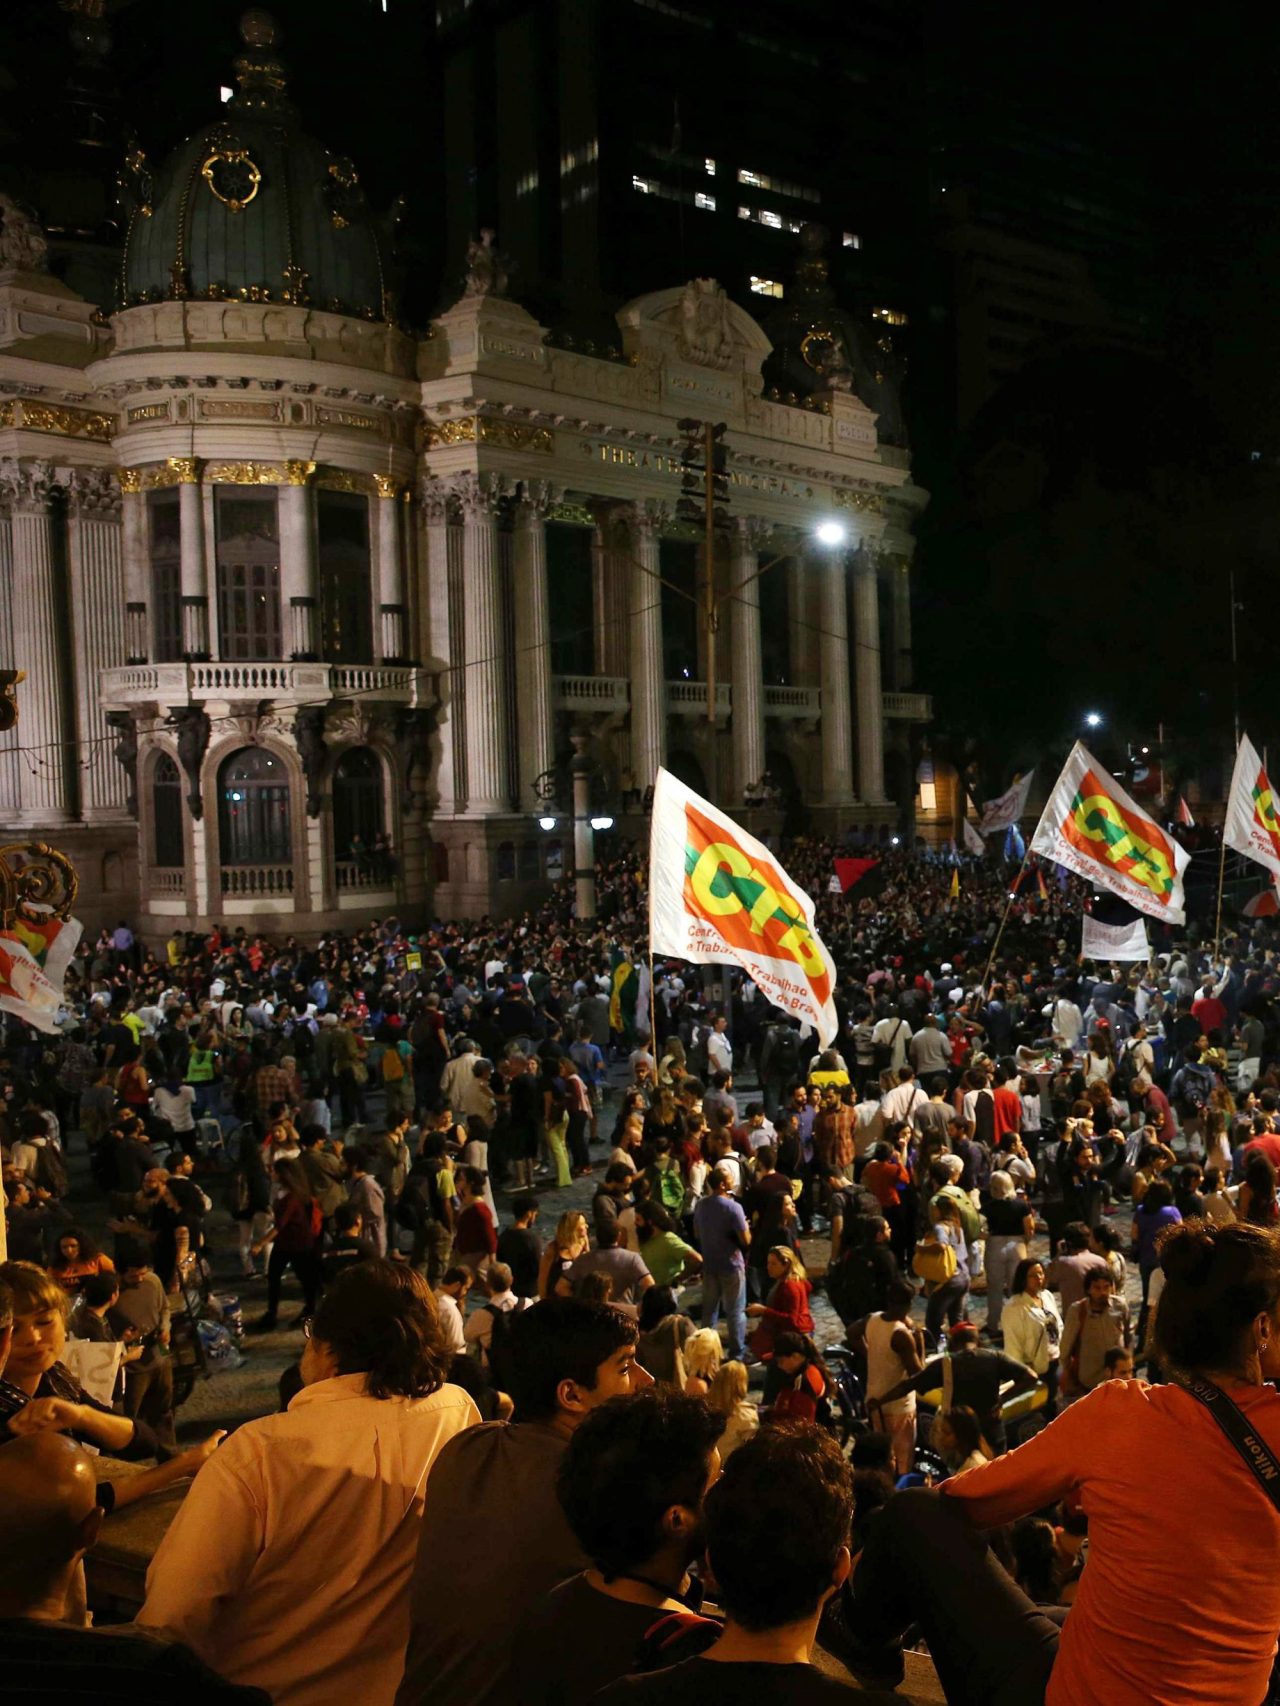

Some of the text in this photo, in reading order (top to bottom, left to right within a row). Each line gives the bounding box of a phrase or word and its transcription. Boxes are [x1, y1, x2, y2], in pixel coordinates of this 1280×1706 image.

[599, 443, 692, 473] THEATR
[691, 842, 827, 978] CTB
[1242, 1435, 1279, 1481] Nikon
